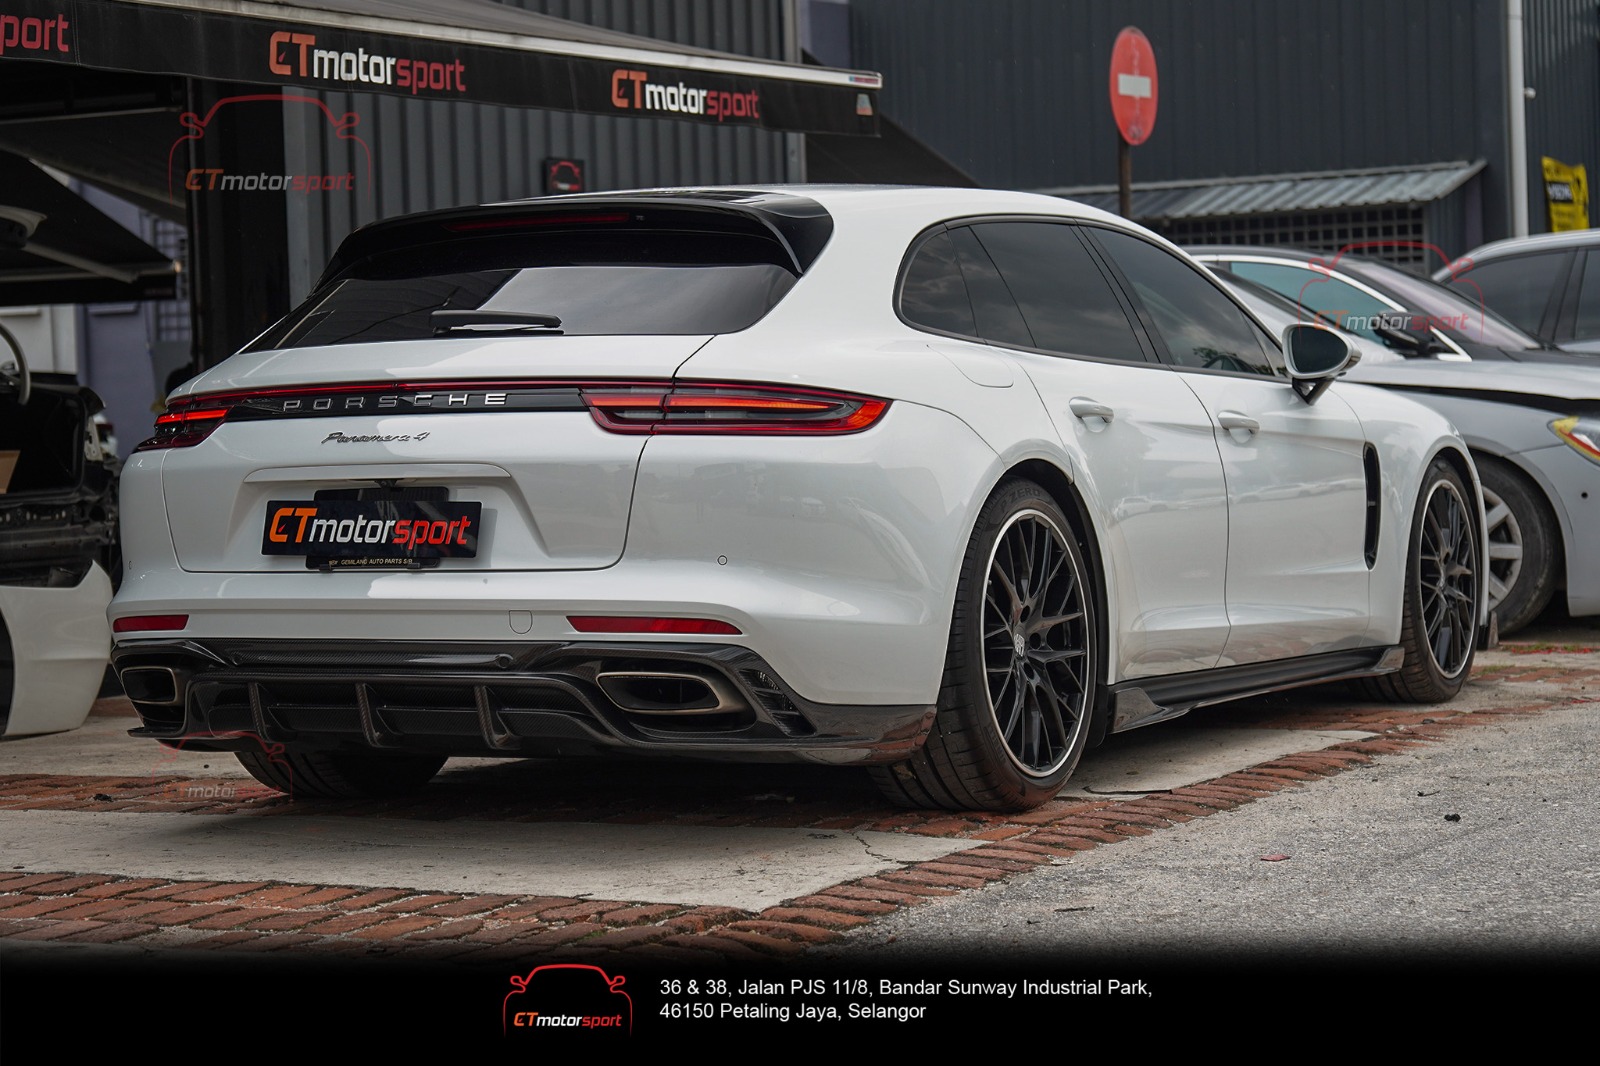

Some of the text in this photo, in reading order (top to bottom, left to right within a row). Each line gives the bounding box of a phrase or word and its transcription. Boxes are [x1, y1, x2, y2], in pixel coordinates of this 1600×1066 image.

[269, 31, 466, 95] CTmotorsport
[611, 69, 760, 122] CTmotorsport
[283, 393, 507, 412] PORSCHE
[321, 431, 431, 444] Panamera 4
[269, 507, 471, 550] CTmotorsport
[369, 558, 384, 566] AUTO
